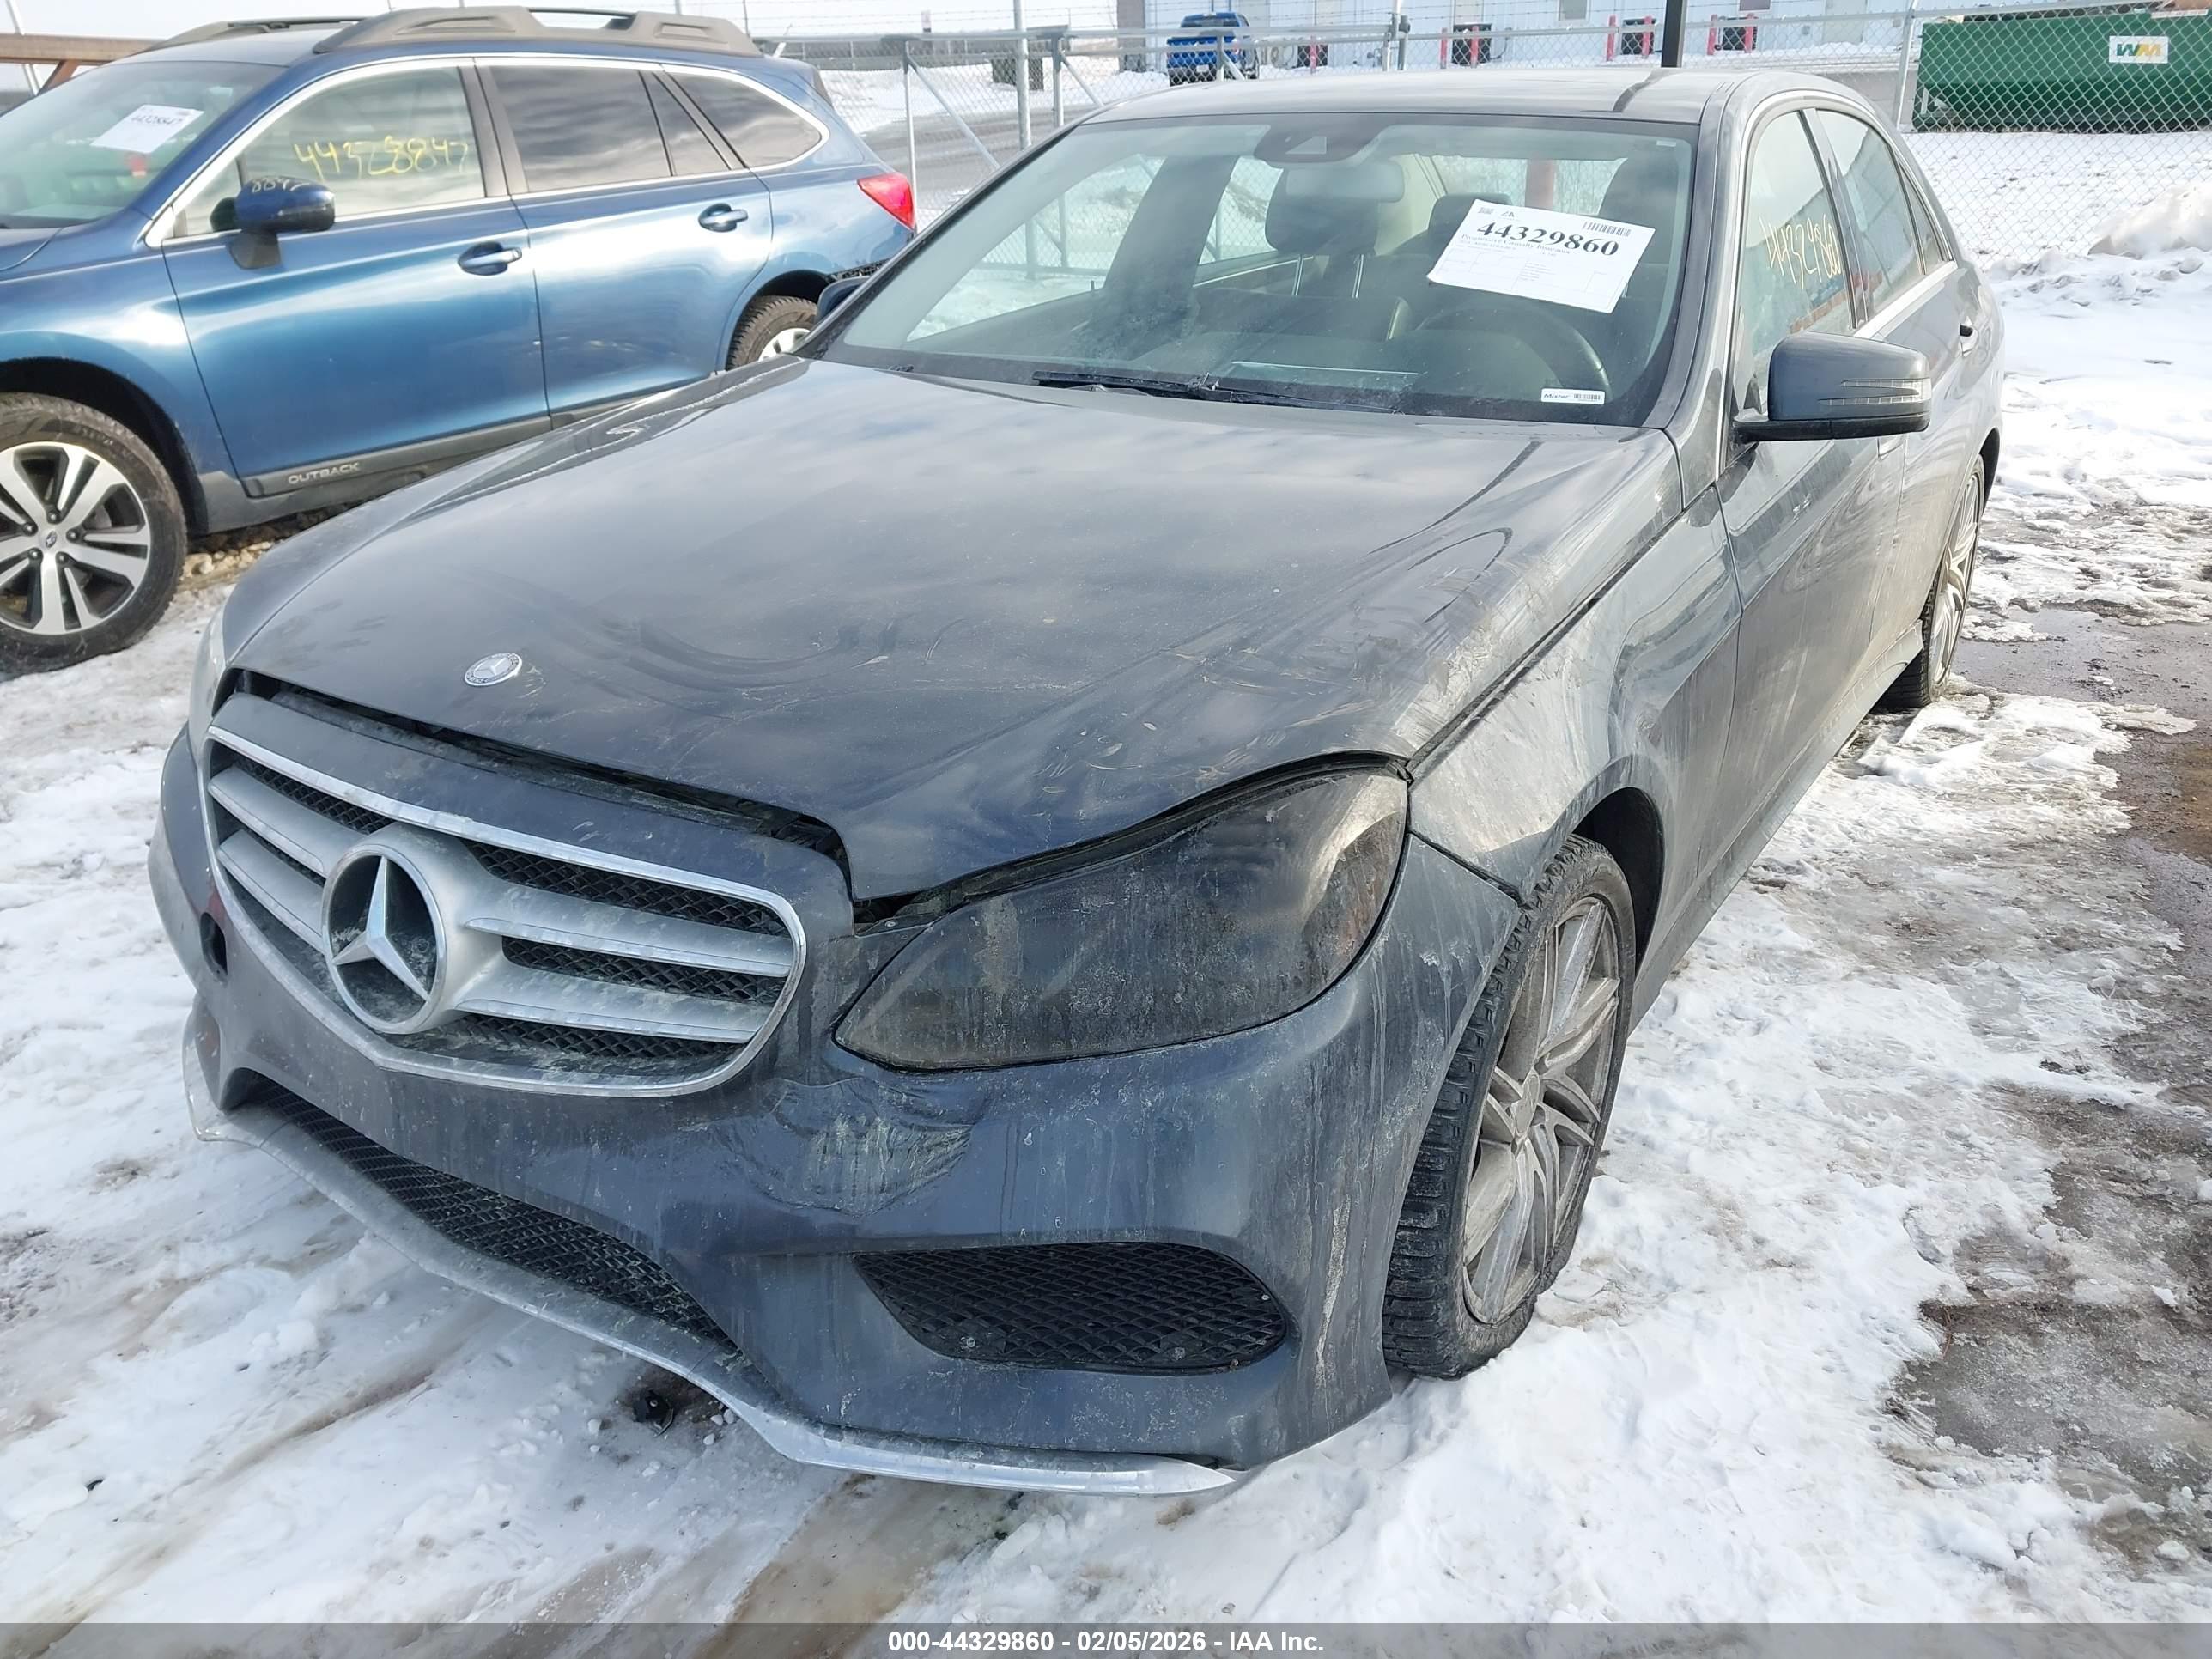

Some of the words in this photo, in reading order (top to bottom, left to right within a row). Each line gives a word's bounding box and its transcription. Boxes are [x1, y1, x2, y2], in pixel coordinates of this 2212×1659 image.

[2117, 44, 2161, 56] WM
[1477, 221, 1620, 256] 44329860
[288, 462, 360, 484] OUTBACK
